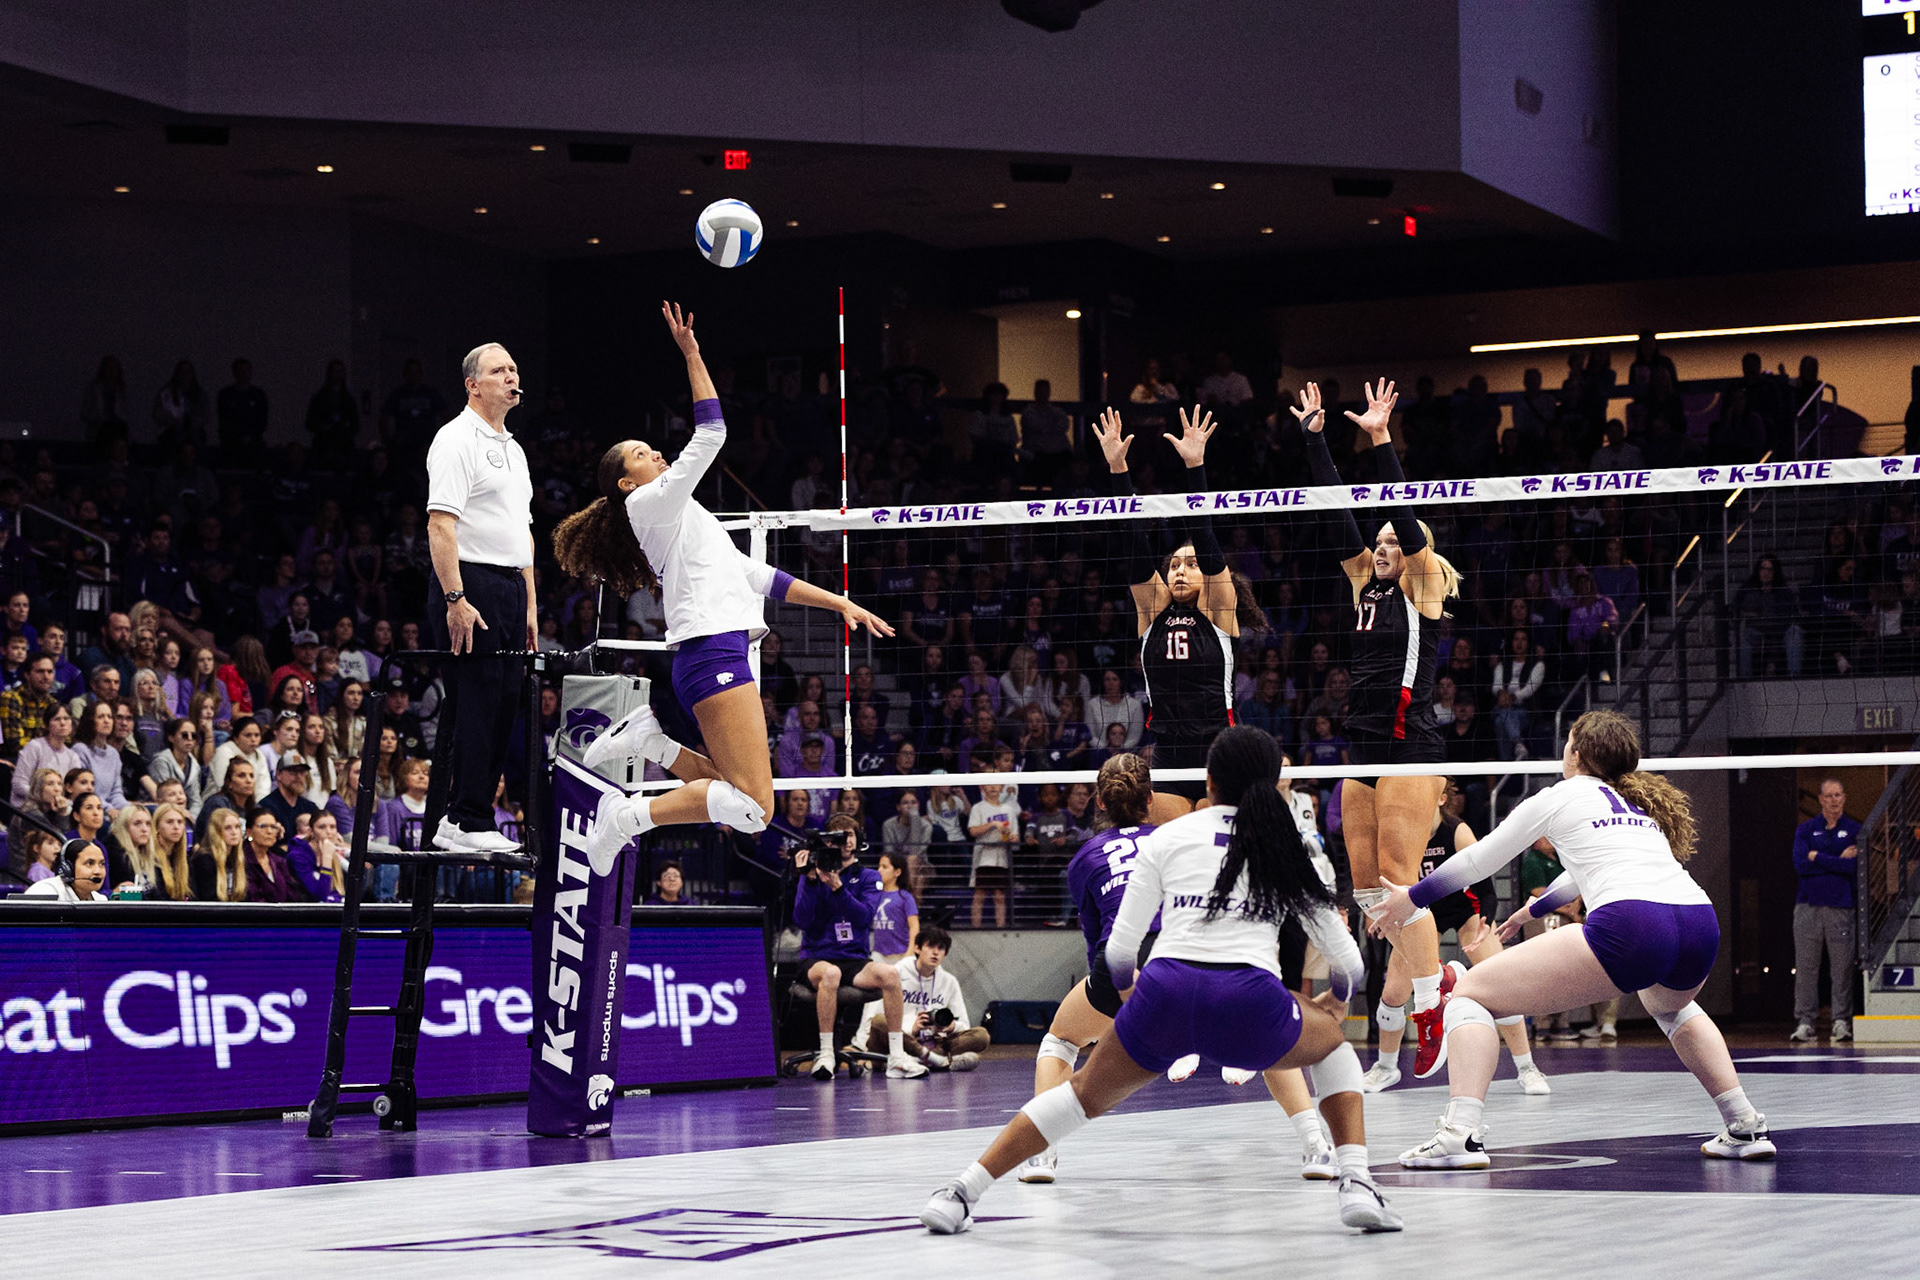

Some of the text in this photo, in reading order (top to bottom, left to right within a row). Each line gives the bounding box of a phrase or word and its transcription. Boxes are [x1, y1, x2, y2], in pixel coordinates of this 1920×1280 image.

[1551, 471, 1651, 493] K-STATE
[1728, 462, 1831, 483] K-STATE
[1214, 489, 1307, 510] K-STATE
[1379, 480, 1475, 501] K-STATE
[898, 505, 985, 523] K-STATE
[1053, 497, 1143, 517] K-STATE
[1356, 601, 1376, 631] 17
[1166, 630, 1189, 660] 16
[1864, 708, 1895, 729] EXIT
[541, 806, 597, 1076] K-STATE
[1892, 969, 1904, 985] 7
[600, 950, 619, 1062] sports imports
